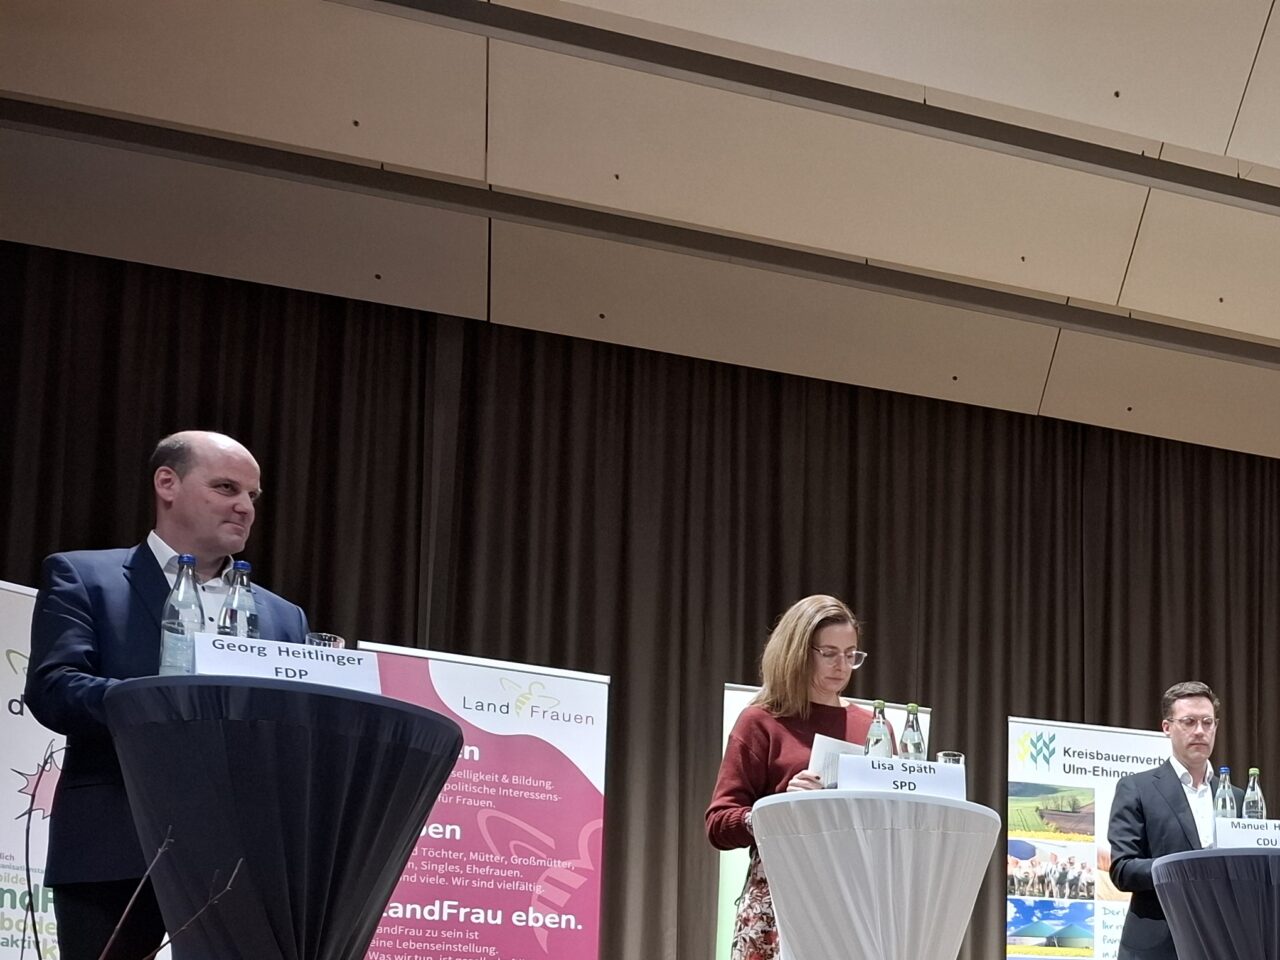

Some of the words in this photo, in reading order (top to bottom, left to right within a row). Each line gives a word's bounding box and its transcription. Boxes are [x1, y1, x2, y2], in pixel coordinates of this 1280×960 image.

[212, 638, 267, 657] Georg
[278, 646, 364, 666] Heitlinger
[274, 666, 308, 680] FDP
[463, 696, 510, 714] Land
[530, 705, 595, 725] Frauen
[871, 760, 894, 771] Lisa
[901, 763, 936, 774] Späth
[501, 774, 509, 783] &
[512, 775, 555, 790] Bildung.
[892, 780, 917, 791] SPD
[444, 782, 497, 797] politische
[499, 786, 562, 801] Interessens-
[456, 795, 496, 809] Frauen.
[1230, 821, 1268, 831] Manuel
[1256, 837, 1278, 847] CDU
[421, 847, 467, 861] Töchter,
[469, 851, 508, 865] Mütter,
[510, 855, 575, 870] Großmütter,
[421, 861, 464, 874] Singles,
[466, 864, 523, 877] Ehefrauen.
[420, 874, 449, 885] viele.
[452, 876, 470, 887] Wir
[472, 879, 494, 889] sind
[496, 880, 545, 894] vielfältig.
[382, 900, 503, 925] andFrau
[511, 906, 583, 930] eben.
[425, 929, 438, 938] zu
[441, 928, 463, 939] sein
[466, 930, 480, 940] ist
[396, 938, 499, 956] Lebenseinstellung.
